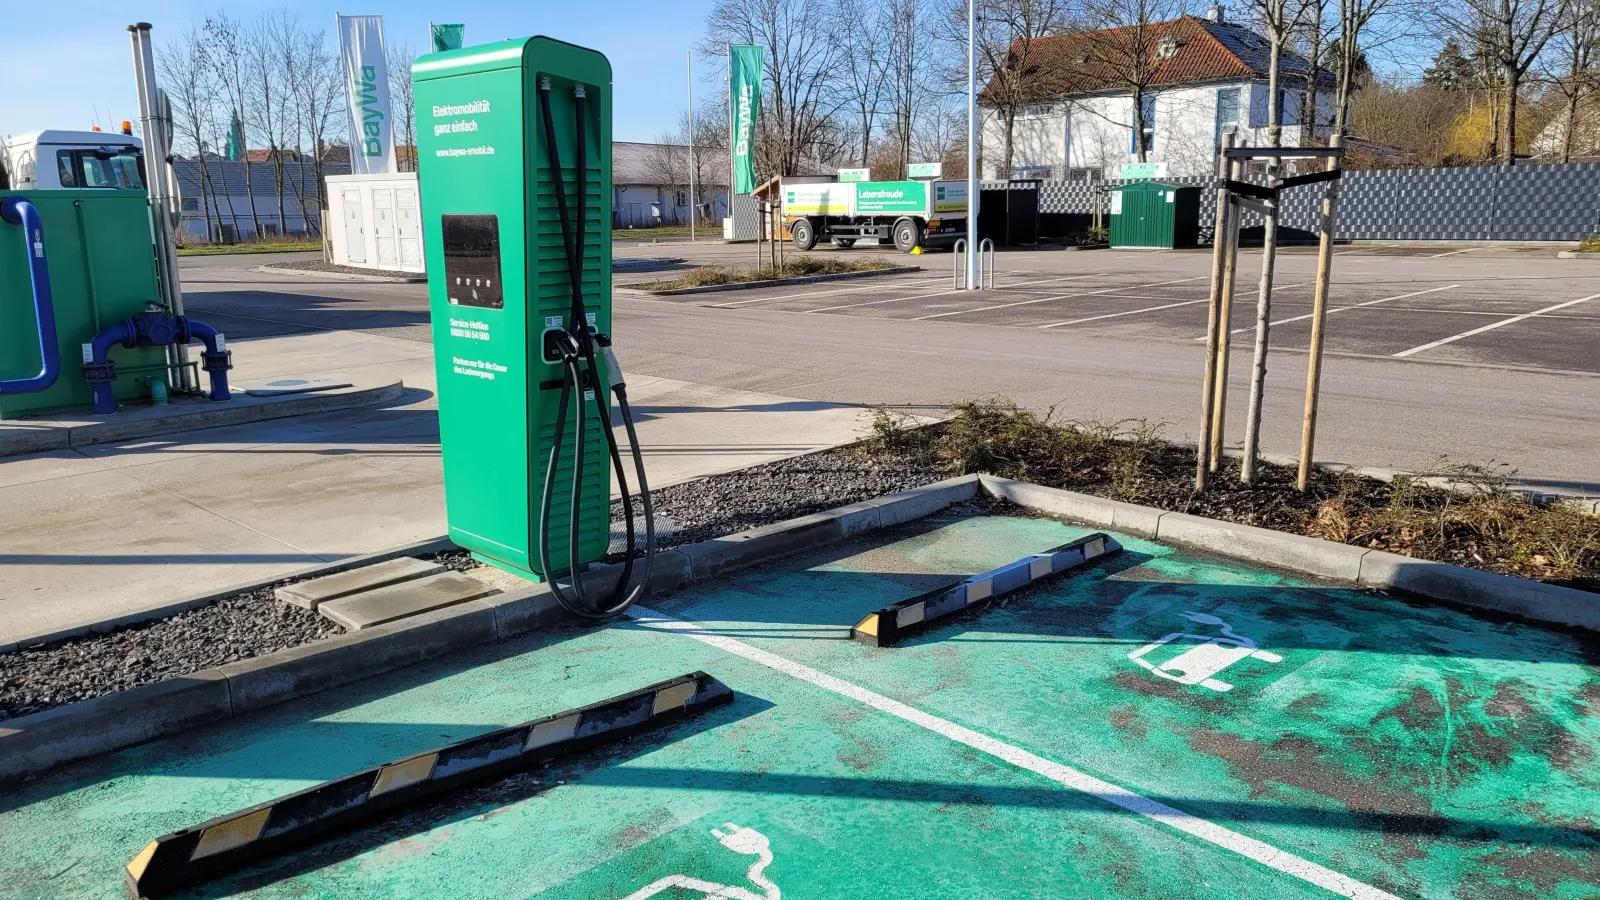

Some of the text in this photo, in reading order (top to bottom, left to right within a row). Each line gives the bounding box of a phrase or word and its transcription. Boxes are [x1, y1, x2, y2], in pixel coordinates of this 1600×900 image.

[354, 65, 385, 157] BayWa
[433, 99, 491, 117] Elektromobilität
[434, 119, 478, 136] ganz einfach
[436, 145, 495, 157] www.baywa-emobil.de
[858, 189, 903, 199] Lebensfreude
[449, 318, 489, 331] Service-Hotline
[453, 356, 470, 366] Parken
